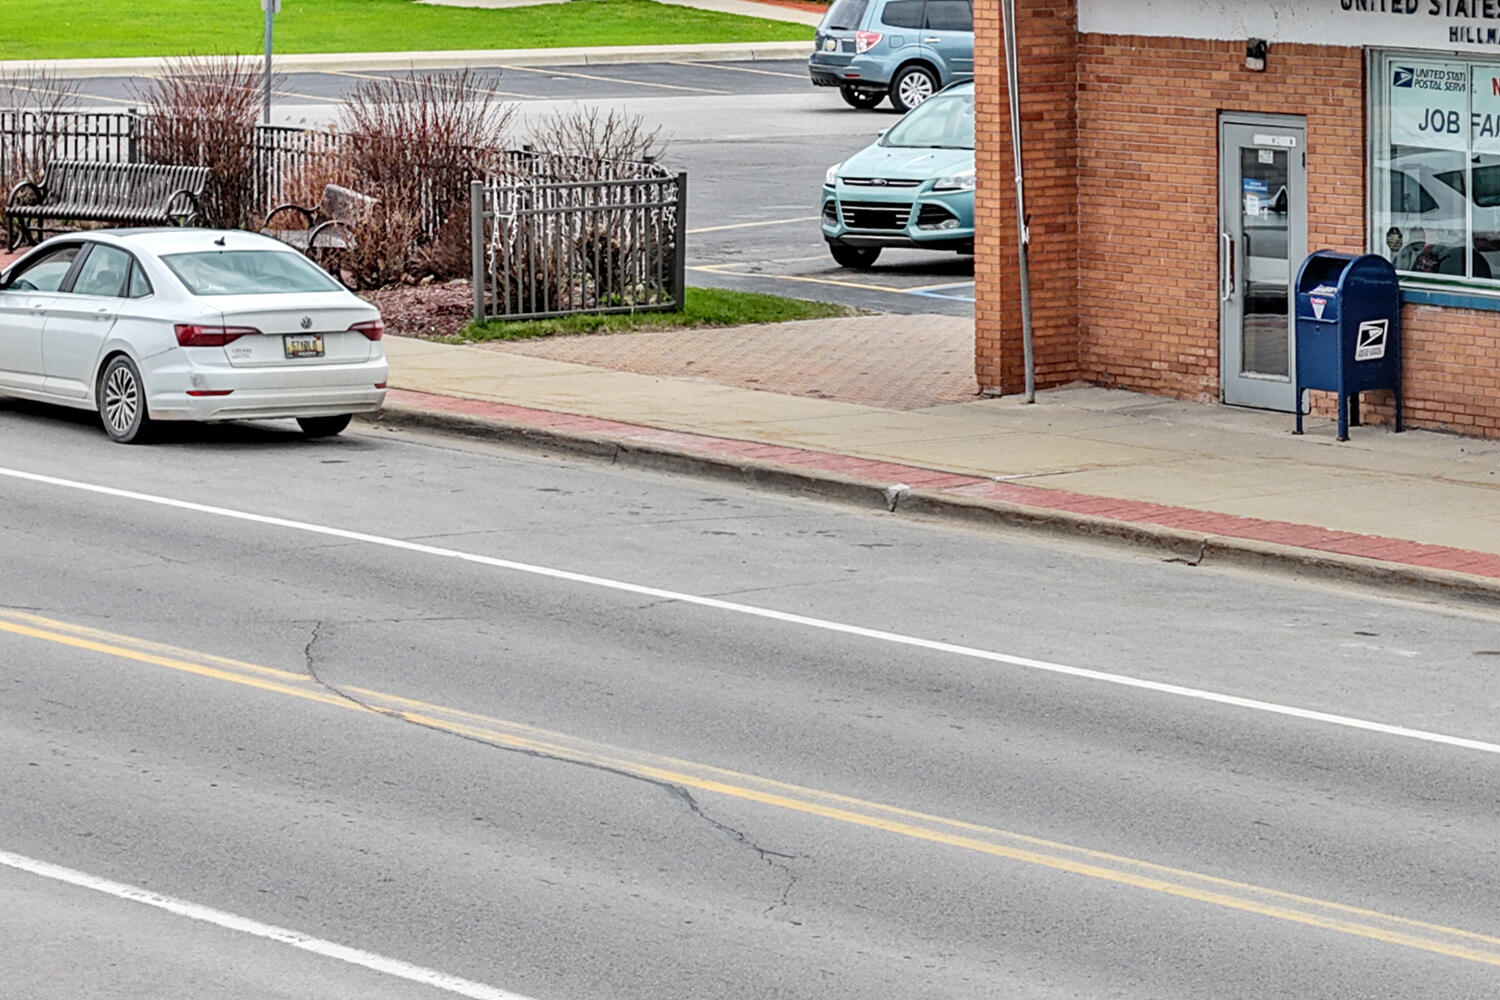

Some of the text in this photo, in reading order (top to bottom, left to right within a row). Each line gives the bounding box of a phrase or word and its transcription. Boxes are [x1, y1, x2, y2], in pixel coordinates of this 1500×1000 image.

[1415, 68, 1467, 82] UNITED STAT
[1414, 78, 1442, 91] POSTAL
[1418, 108, 1460, 134] JOB
